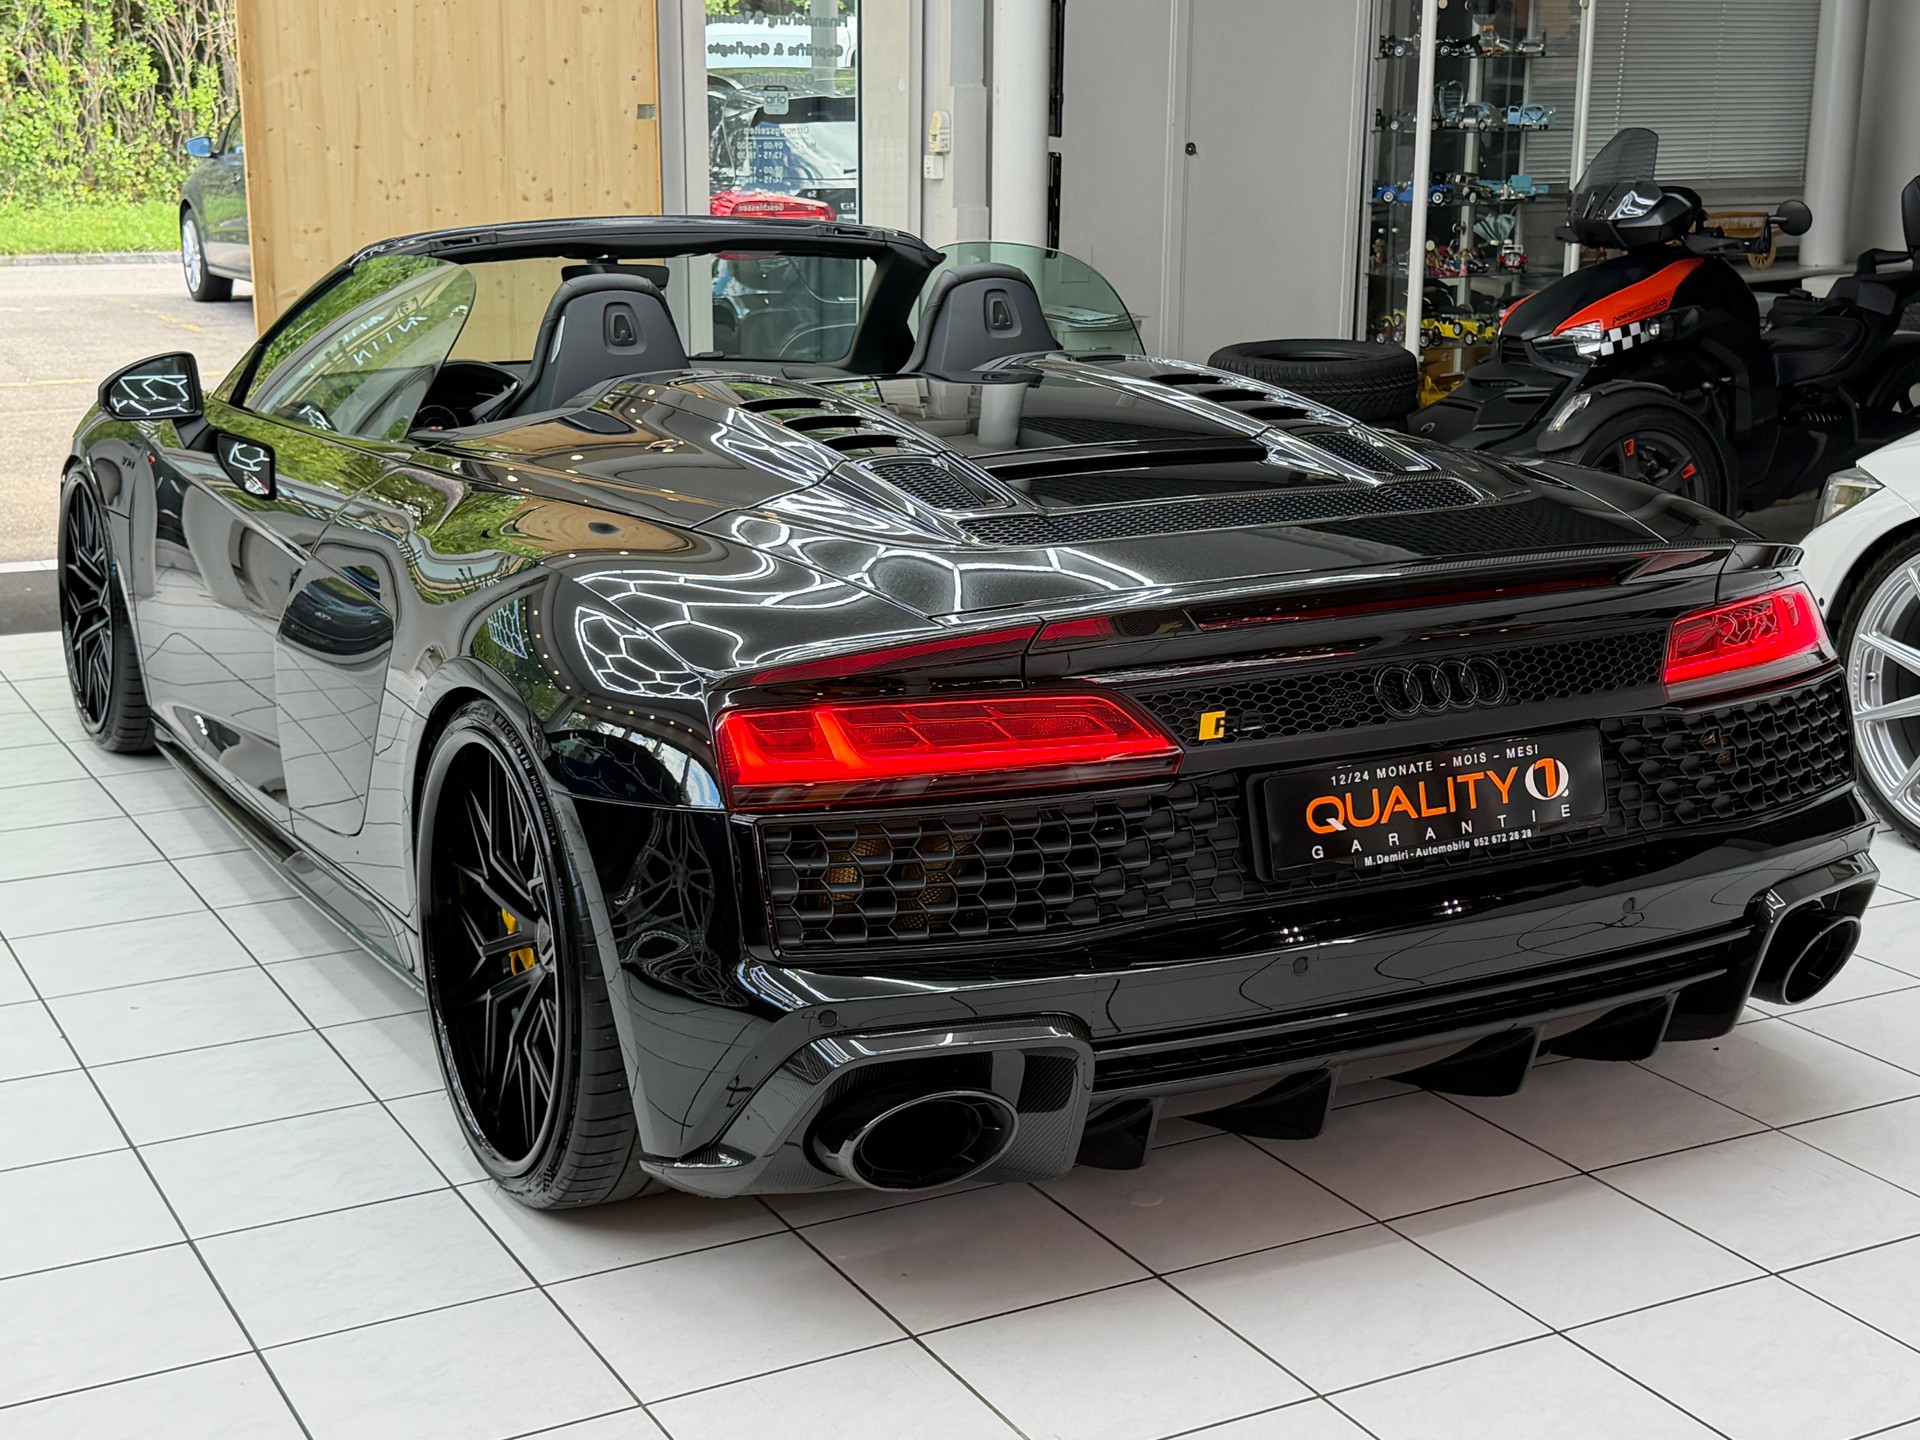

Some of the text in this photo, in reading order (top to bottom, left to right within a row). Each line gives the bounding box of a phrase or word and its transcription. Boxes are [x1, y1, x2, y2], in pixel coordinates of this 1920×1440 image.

[495, 713, 532, 770] MICHELIN
[1330, 770, 1370, 786] 12/24
[1376, 760, 1434, 779] MONATE
[1453, 752, 1487, 767] MOIS
[1506, 743, 1539, 759] MESI
[1306, 766, 1519, 834] QUALITY
[1312, 803, 1571, 859] GARANTIE
[1474, 836, 1489, 847] 052
[1491, 833, 1508, 843] 672
[1509, 831, 1520, 840] 28
[1521, 828, 1532, 838] 28
